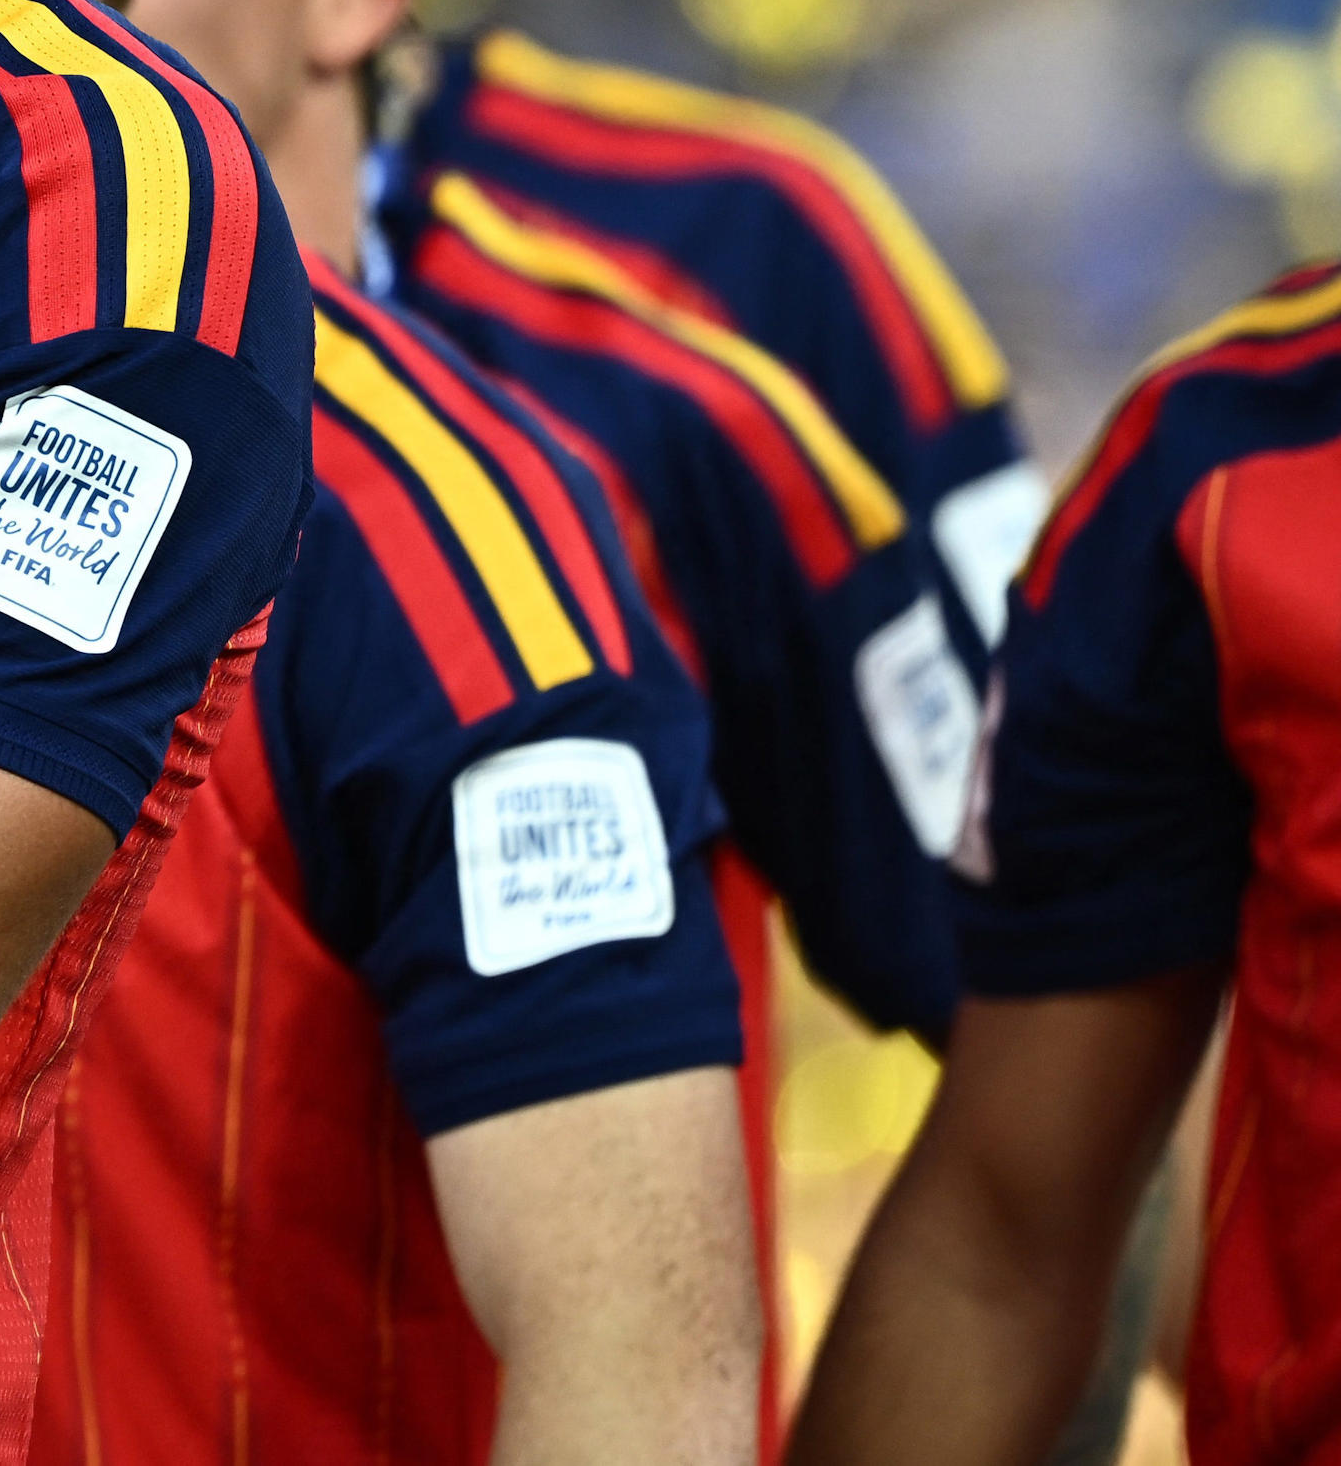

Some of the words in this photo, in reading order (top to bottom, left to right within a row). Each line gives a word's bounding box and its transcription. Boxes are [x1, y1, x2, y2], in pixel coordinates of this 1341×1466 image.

[21, 419, 139, 498] FOOTBALL
[0, 449, 129, 538] UNITES
[0, 548, 52, 586] FIFA
[25, 517, 120, 585] World
[500, 818, 625, 863] UNITES
